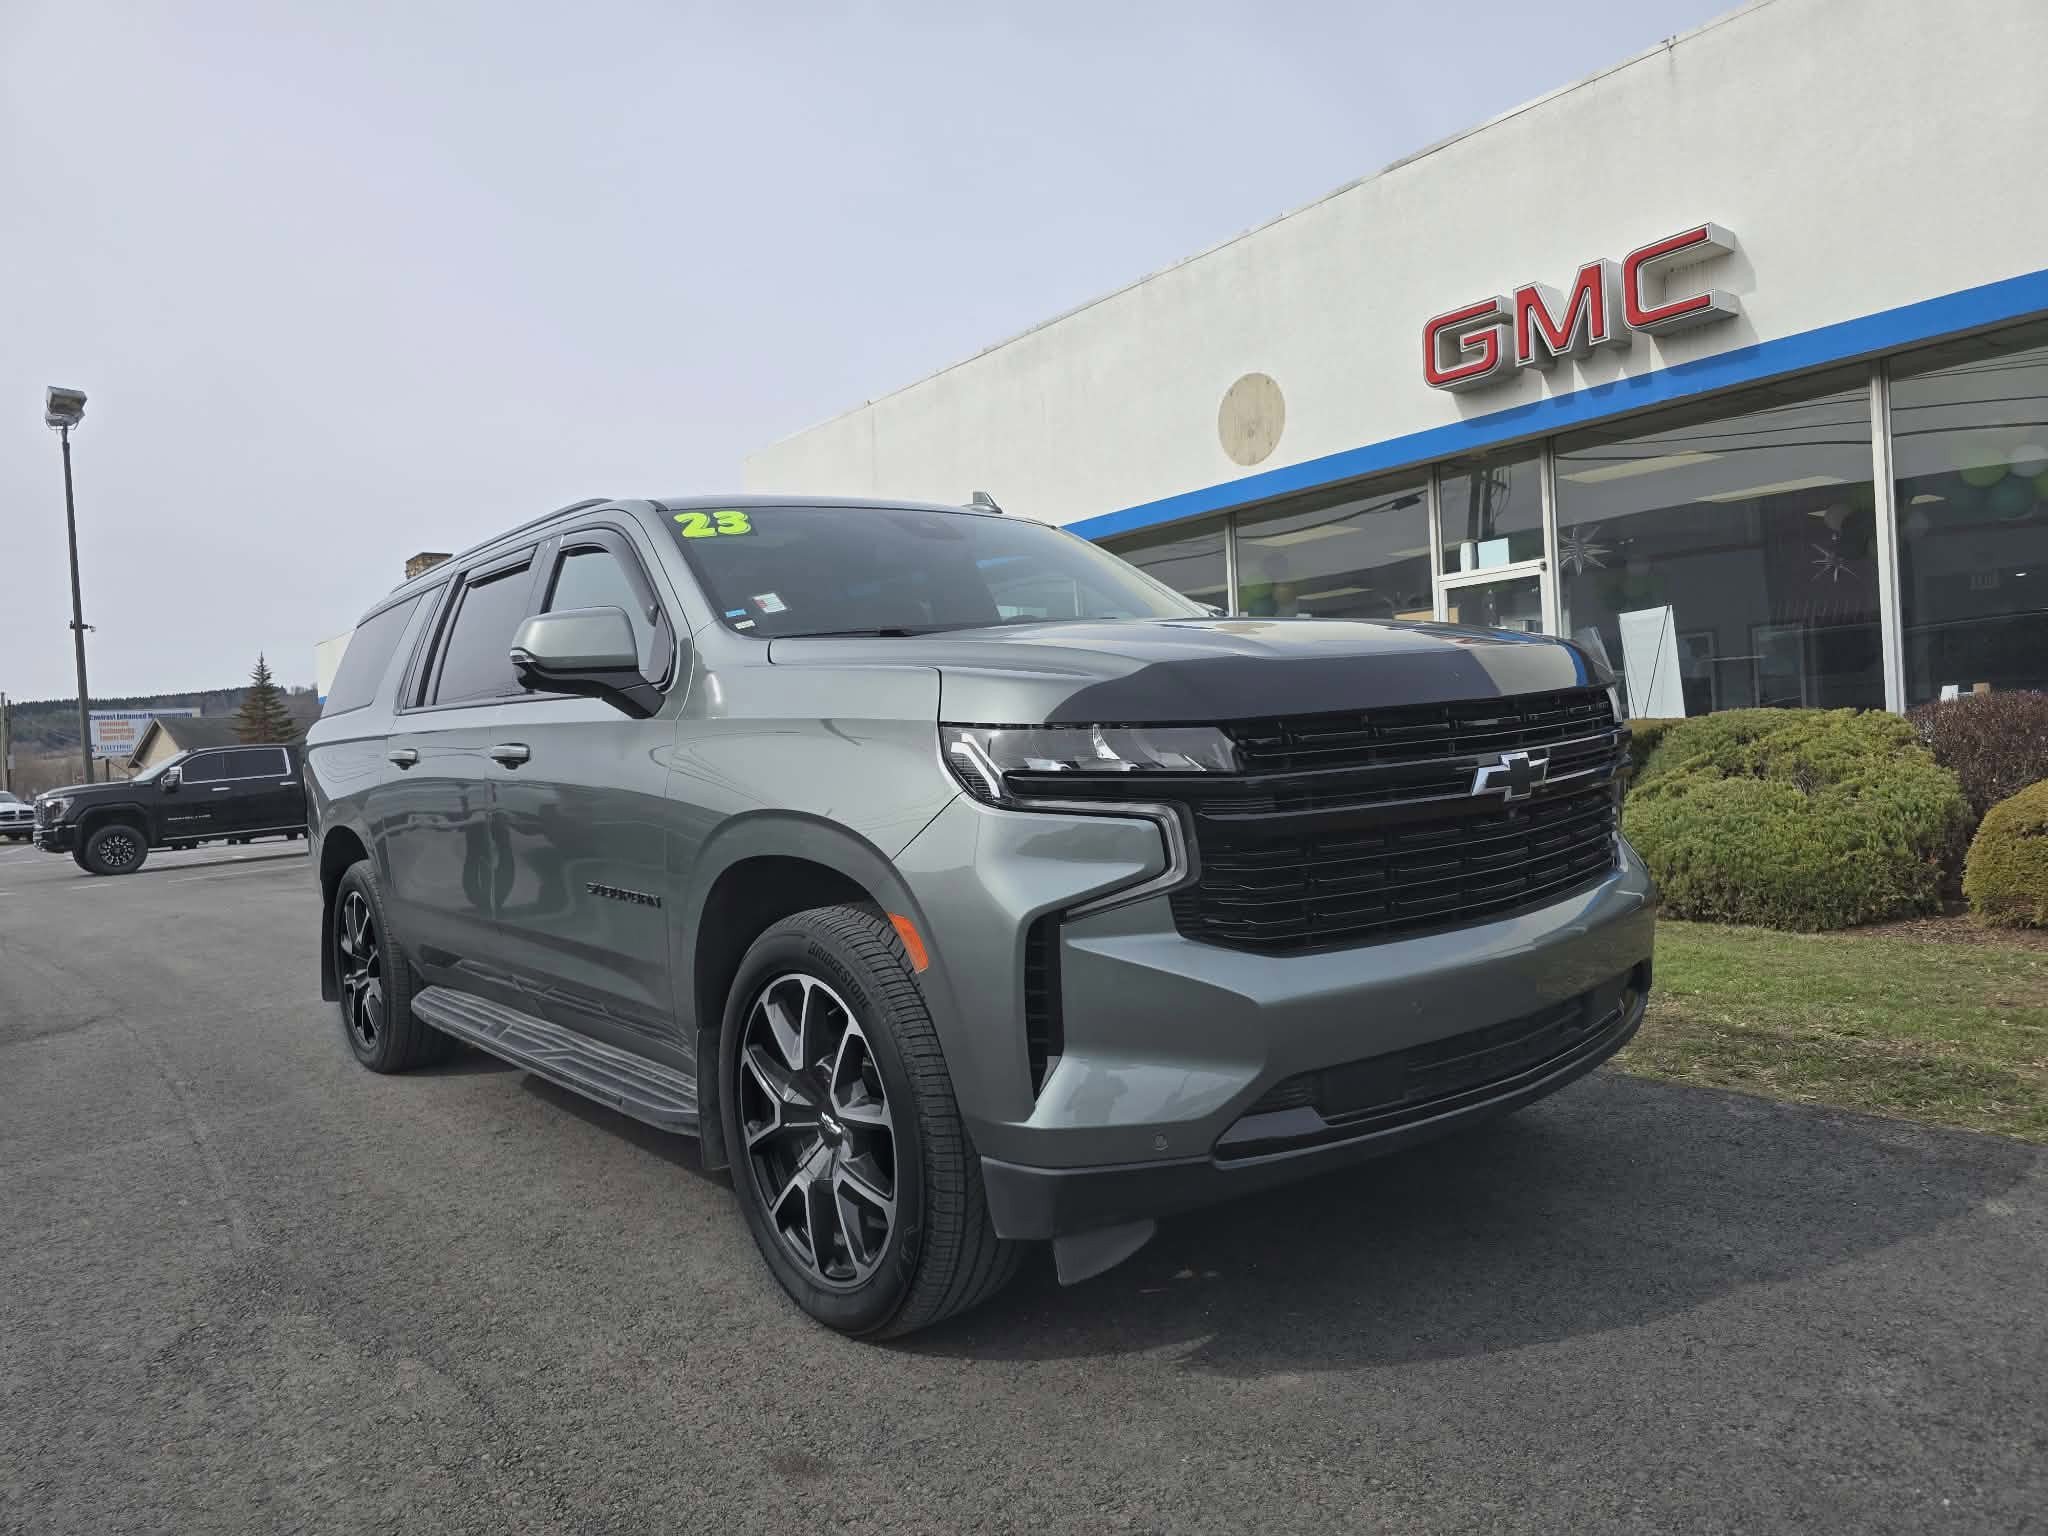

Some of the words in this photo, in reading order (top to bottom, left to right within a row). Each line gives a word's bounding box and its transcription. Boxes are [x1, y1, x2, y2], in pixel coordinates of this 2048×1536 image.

[1422, 222, 1736, 390] GMC
[673, 511, 751, 538] 23
[808, 940, 873, 1011] BRIDGESTONE
